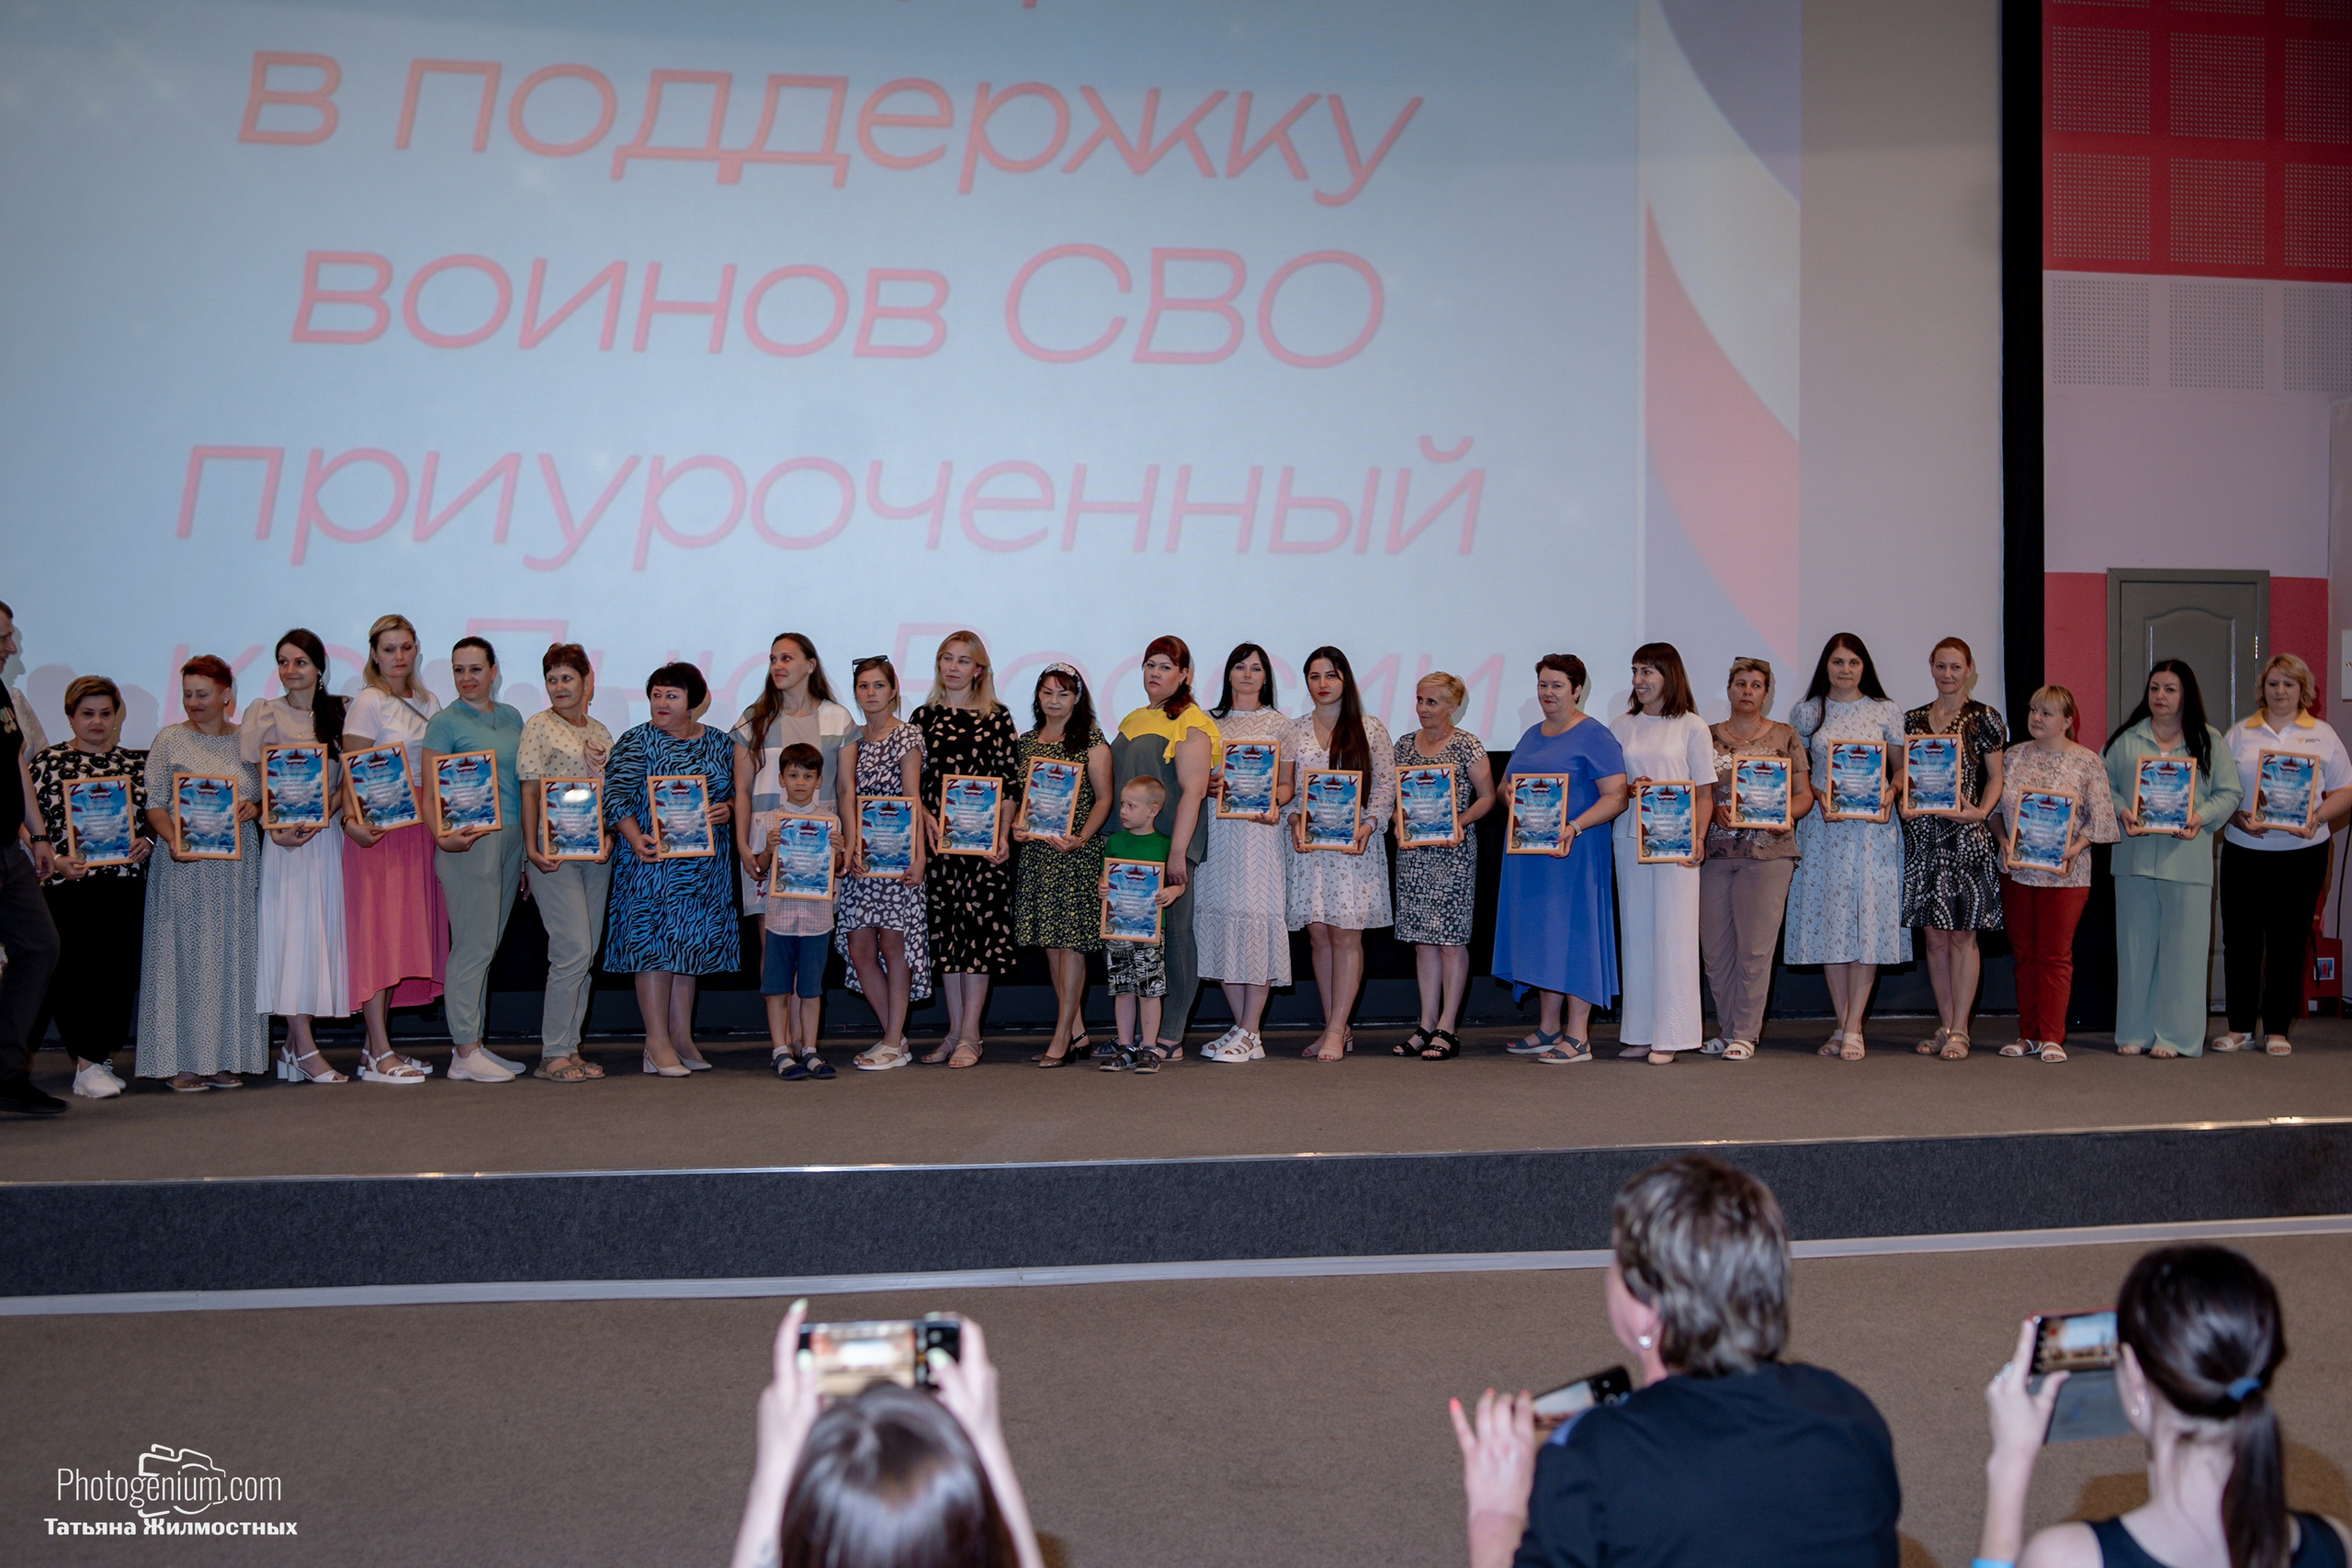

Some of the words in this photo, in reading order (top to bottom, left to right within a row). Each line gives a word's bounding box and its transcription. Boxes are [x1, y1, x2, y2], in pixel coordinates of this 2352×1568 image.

[396, 59, 1420, 207] поддержку
[291, 251, 948, 357] воинов
[1005, 244, 1384, 367] СВО
[178, 437, 1484, 570] приуроченный
